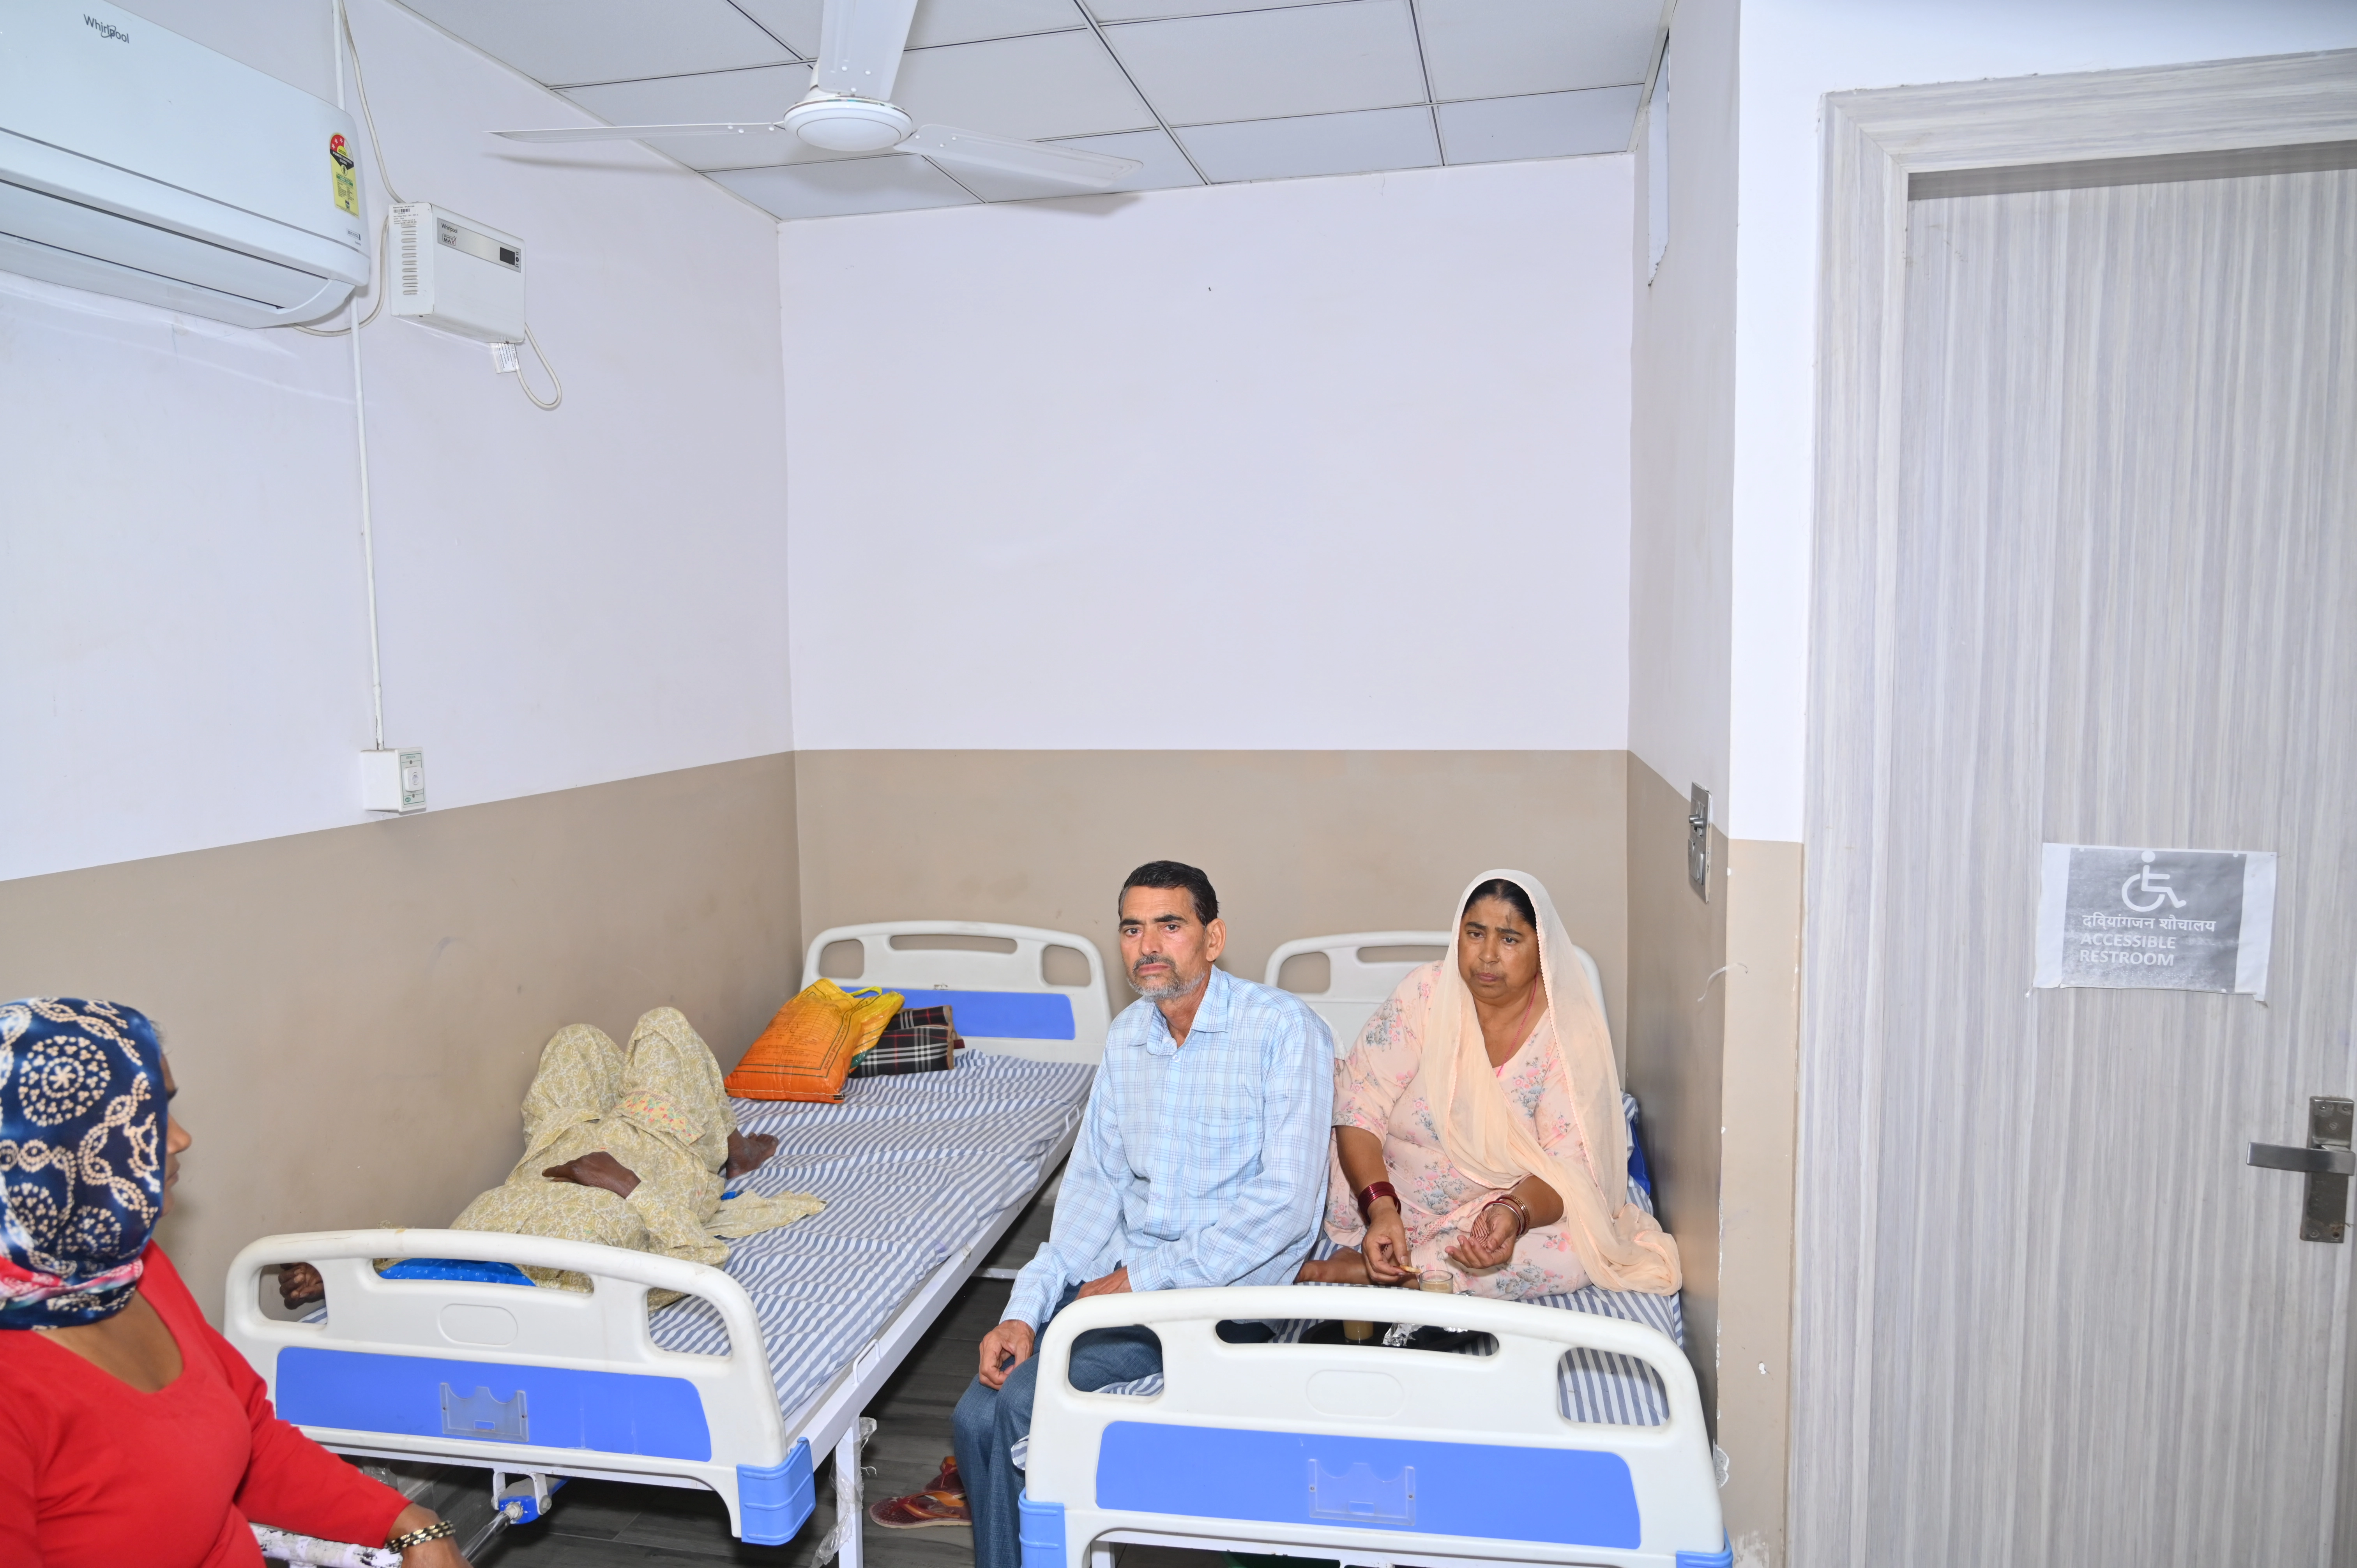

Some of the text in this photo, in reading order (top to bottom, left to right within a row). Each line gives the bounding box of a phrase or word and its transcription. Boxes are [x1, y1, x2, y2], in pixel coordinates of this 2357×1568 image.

[83, 14, 129, 44] Whirlpool
[441, 222, 458, 234] Whirlpool
[443, 237, 457, 245] MAX
[2158, 914, 2217, 932] शौचालय
[2080, 932, 2177, 949] ACCESSIBLE
[2080, 949, 2175, 966] RESTROOM
